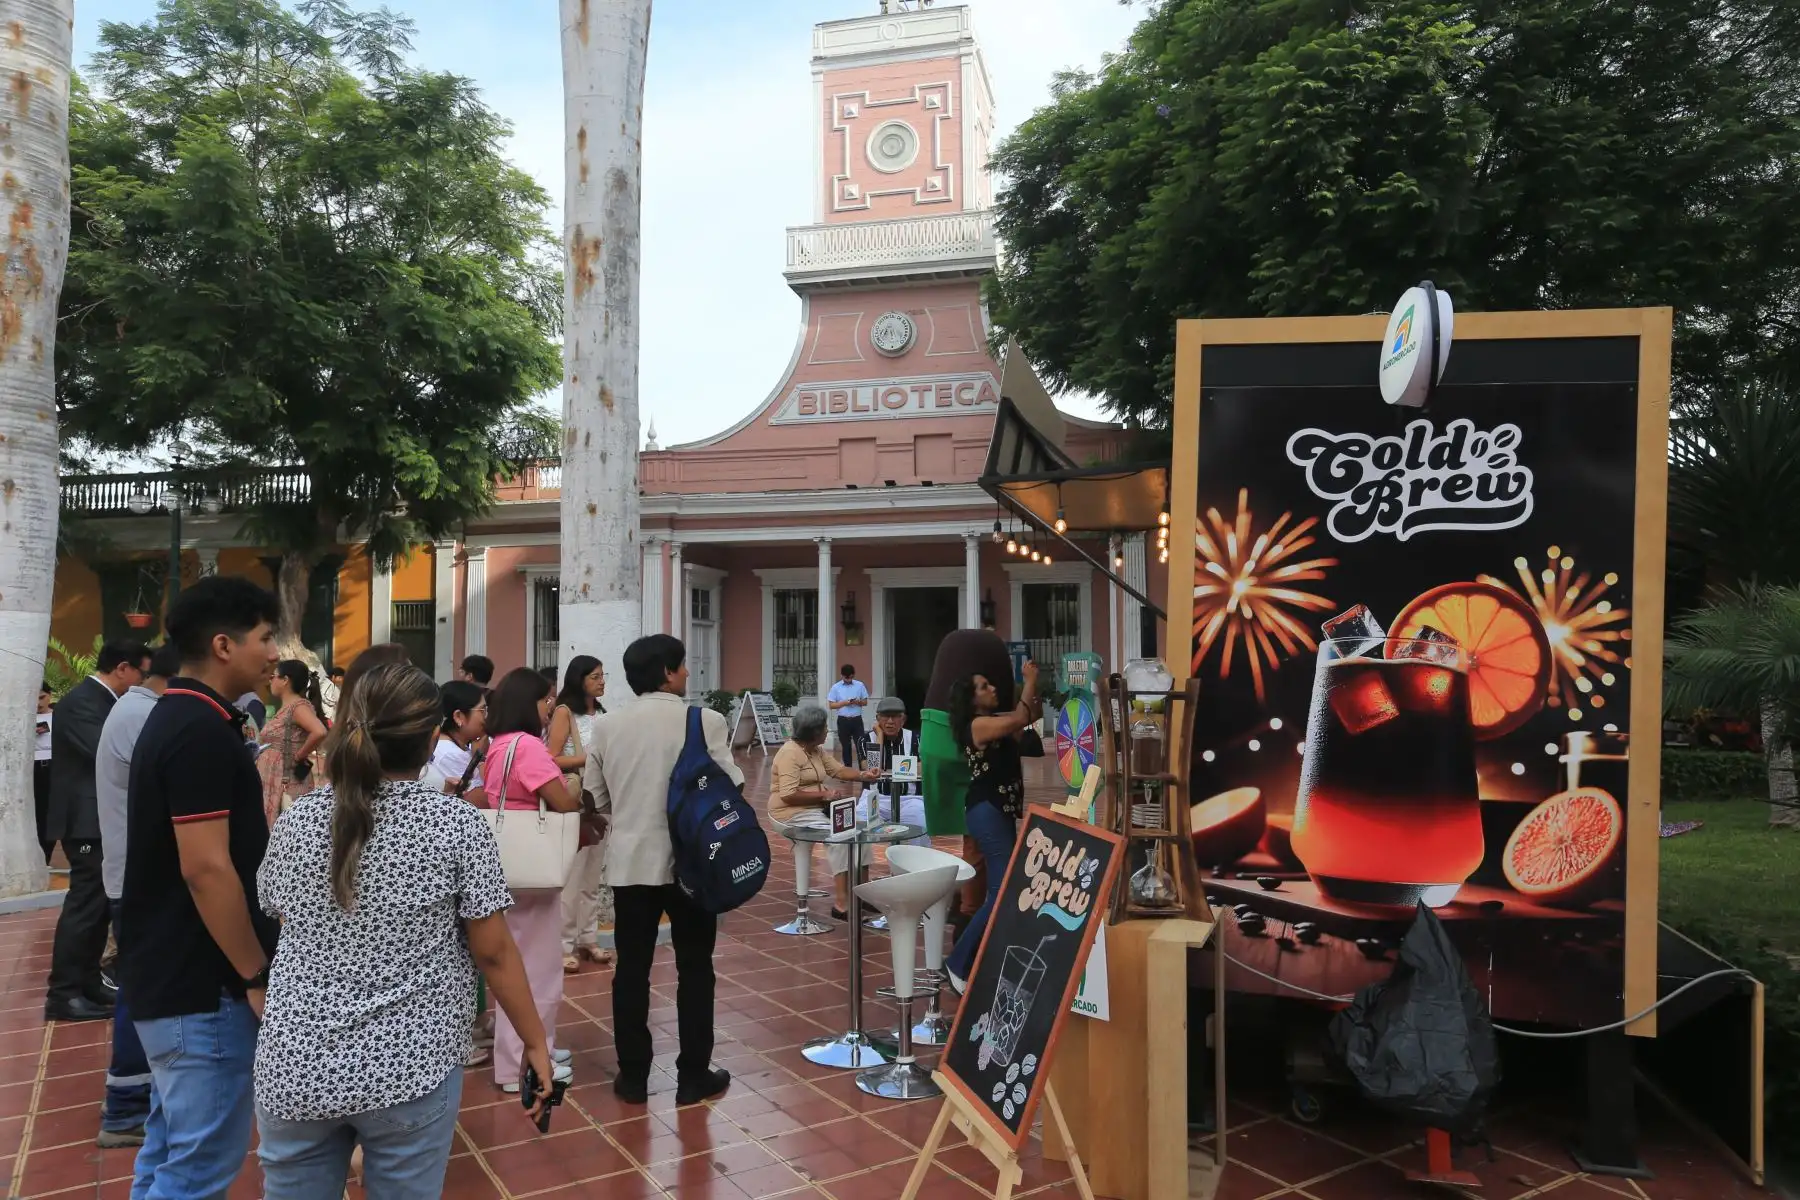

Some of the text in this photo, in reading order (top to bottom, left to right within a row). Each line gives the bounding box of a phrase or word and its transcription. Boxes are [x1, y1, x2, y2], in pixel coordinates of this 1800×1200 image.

[799, 380, 998, 415] BIBLIOTECA
[1290, 421, 1470, 496] Cold
[1331, 467, 1529, 538] Brew
[731, 856, 763, 880] MINSA
[1024, 827, 1087, 880] Cold
[1018, 871, 1090, 916] Brew
[1071, 999, 1098, 1014] RCADO
